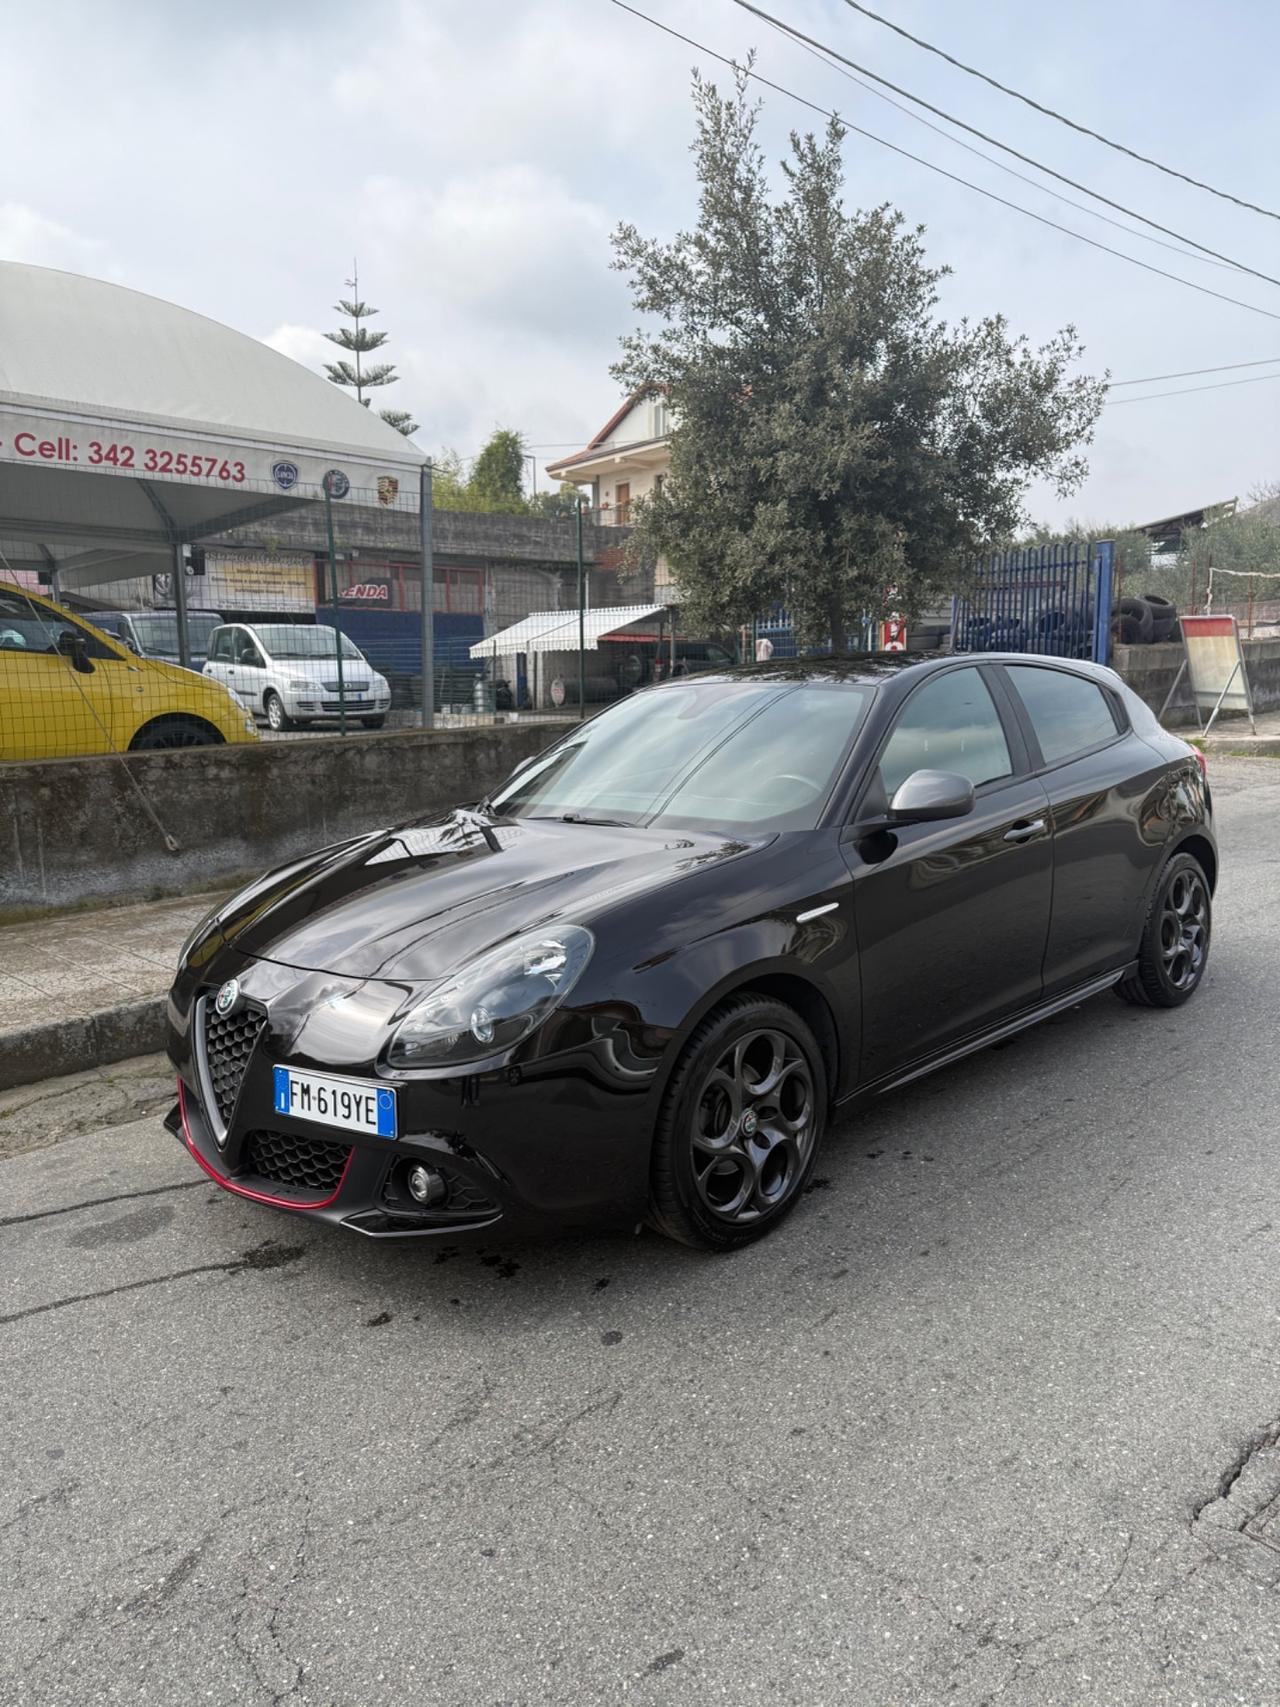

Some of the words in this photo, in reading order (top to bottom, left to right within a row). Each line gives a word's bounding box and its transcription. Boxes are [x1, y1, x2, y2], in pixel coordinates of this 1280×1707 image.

[14, 432, 78, 461] Cell:
[88, 441, 135, 468] 342
[144, 448, 245, 483] 3255763
